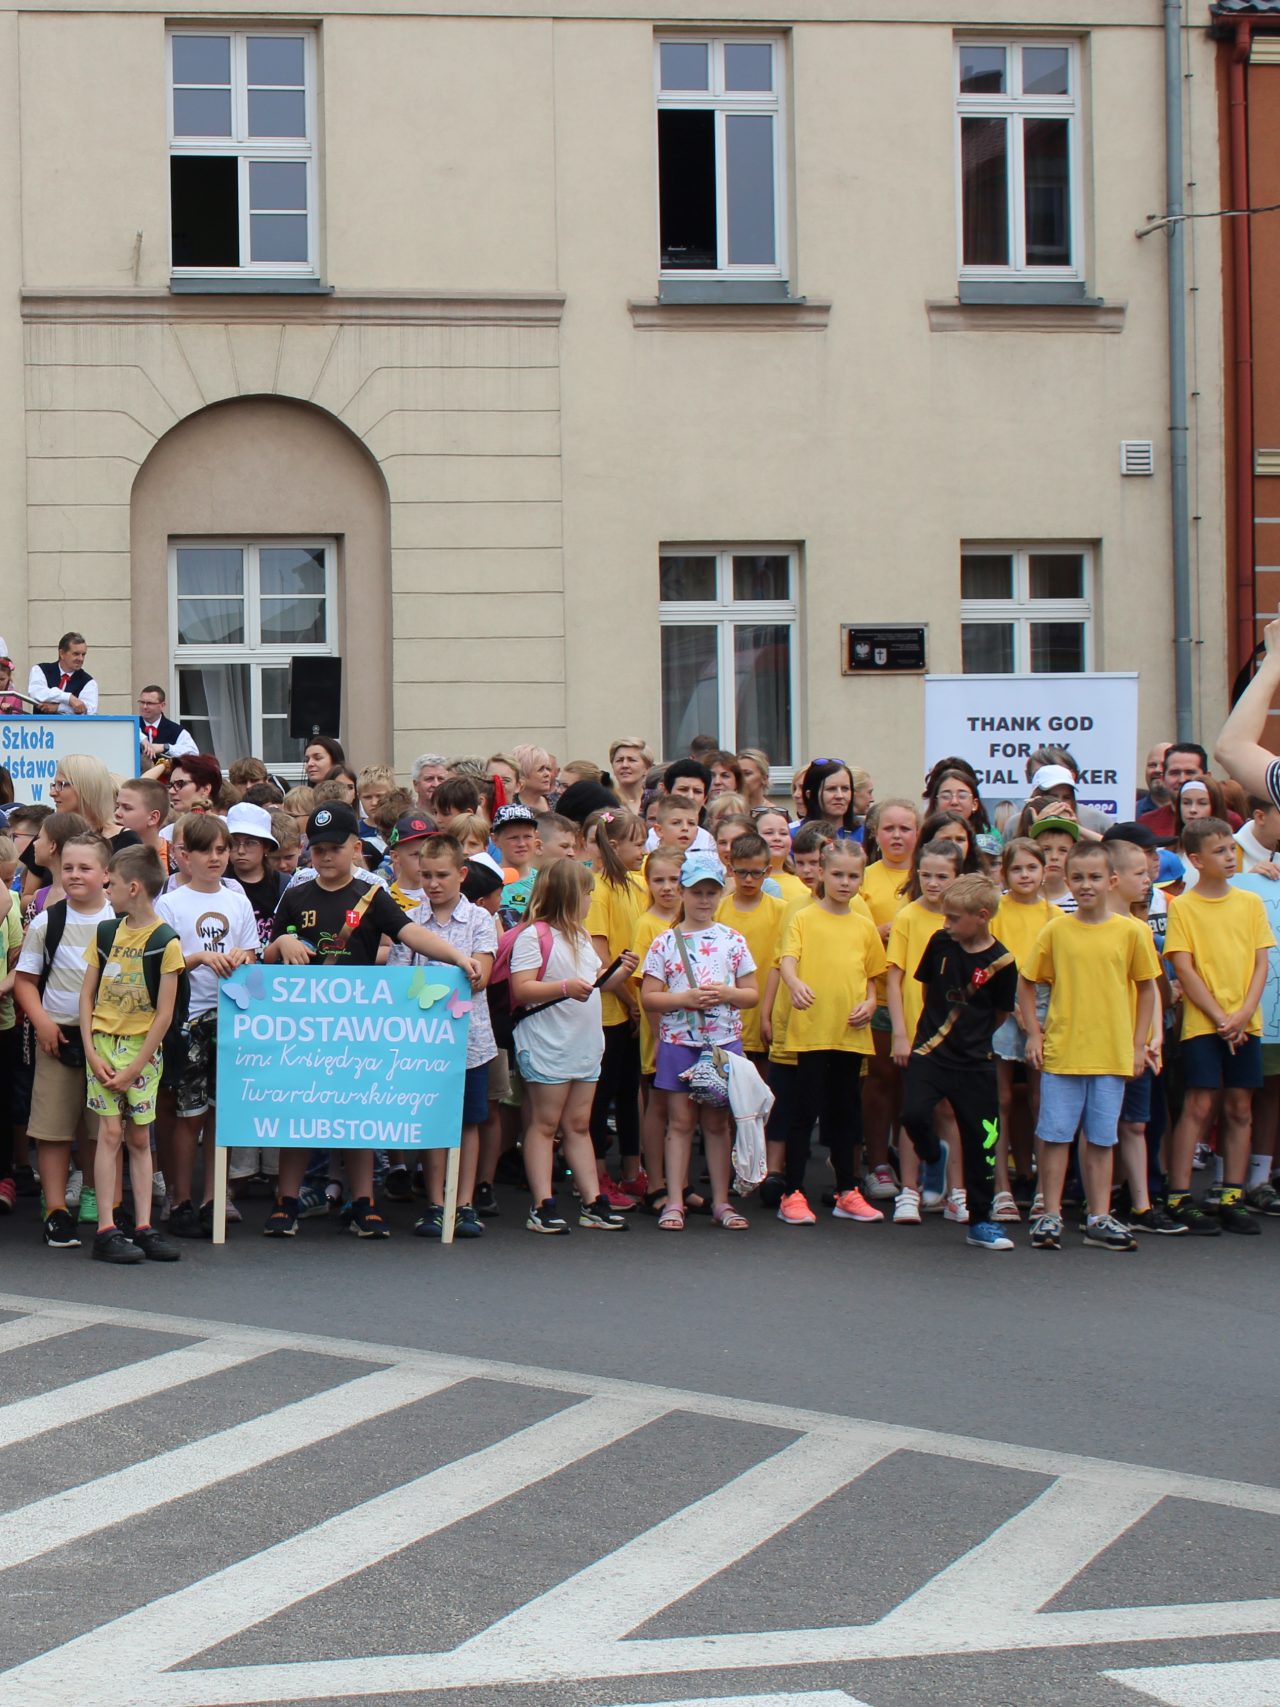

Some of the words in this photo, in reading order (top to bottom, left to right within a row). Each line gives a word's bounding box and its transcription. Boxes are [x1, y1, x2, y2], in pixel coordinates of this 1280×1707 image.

[967, 716, 1041, 731] THANK
[1047, 716, 1094, 731] GOD
[2, 725, 55, 750] Szkoła
[989, 743, 1031, 758] FOR
[200, 926, 227, 938] WHY
[301, 910, 317, 928] 33
[271, 976, 394, 1005] SZKOŁA
[233, 1014, 456, 1045] PODSTAWOWA
[235, 1046, 273, 1067] im.
[279, 1044, 384, 1080] Księdza
[385, 1047, 451, 1081] Jana
[240, 1078, 440, 1115] Twardowskiego
[254, 1117, 280, 1138] W
[289, 1118, 423, 1144] LUBSTOWIE
